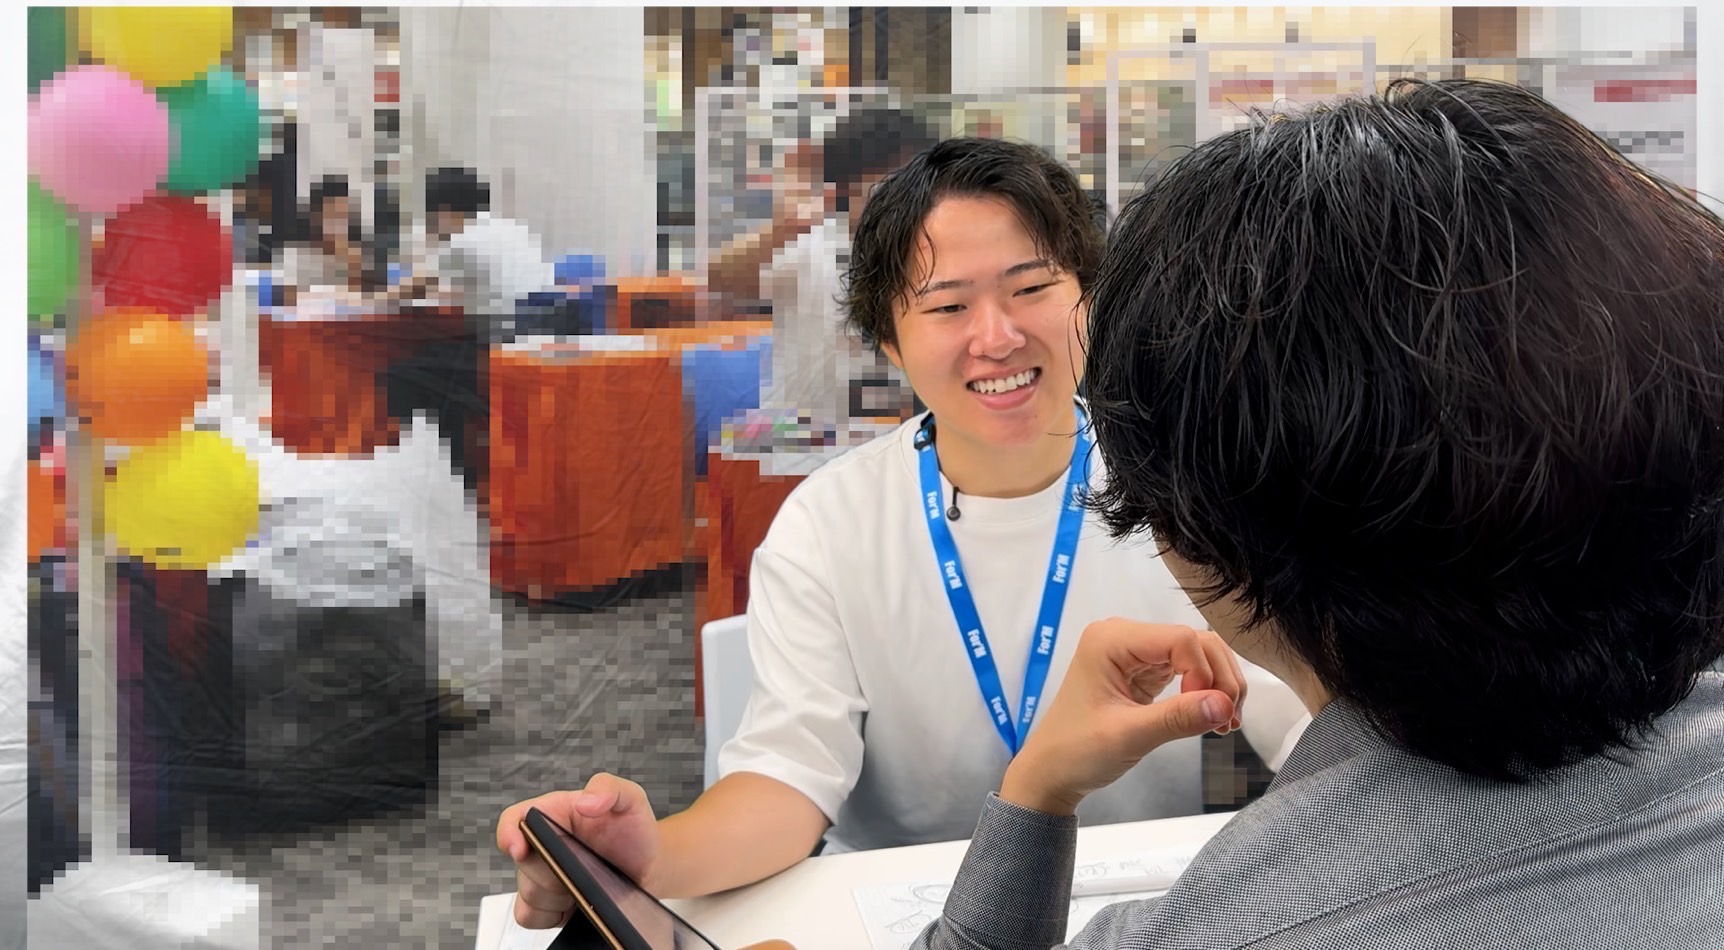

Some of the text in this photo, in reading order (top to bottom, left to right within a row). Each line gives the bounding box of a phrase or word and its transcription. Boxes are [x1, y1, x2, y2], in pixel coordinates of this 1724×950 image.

[927, 490, 940, 519] For'M
[944, 560, 962, 590] For'M
[1052, 553, 1069, 583] For'M
[967, 629, 987, 658] For'M
[1037, 625, 1054, 655] For'M
[991, 696, 1008, 725] For'M
